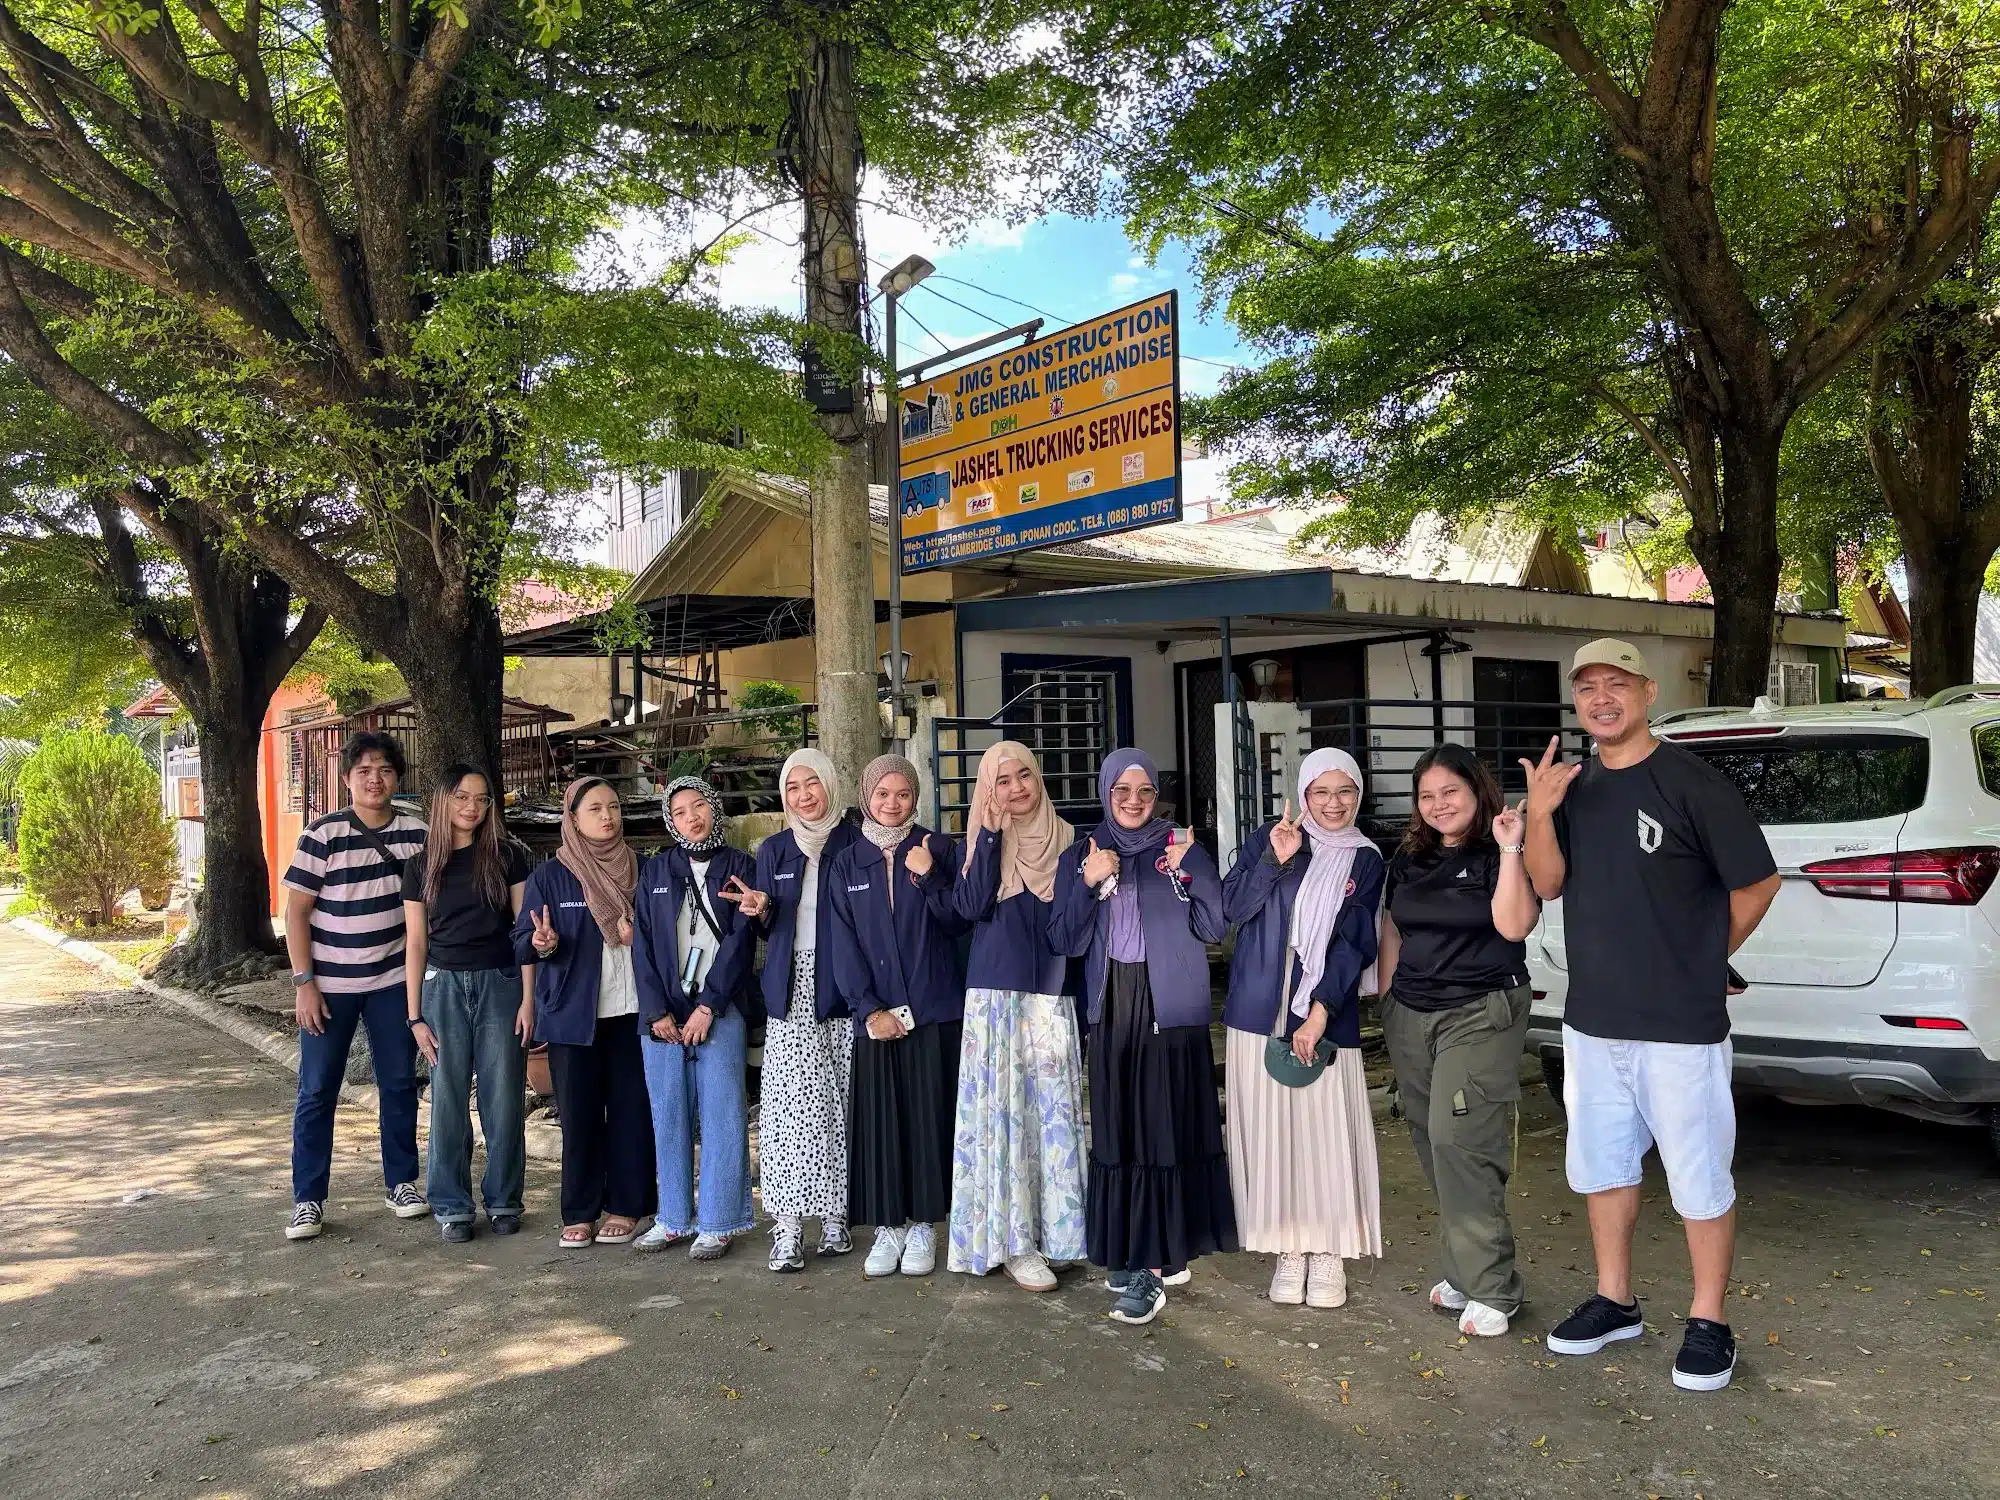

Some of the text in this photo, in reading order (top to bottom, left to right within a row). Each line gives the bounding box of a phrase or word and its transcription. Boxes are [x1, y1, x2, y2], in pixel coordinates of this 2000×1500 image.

[955, 302, 1171, 397] JMG CONSTRUCTION
[955, 333, 1172, 422] & GENERAL MERCHANDISE
[951, 399, 1173, 489] JASHEL TRUCKING SERVICES
[916, 477, 932, 495] JTS
[971, 496, 993, 510] FAST
[903, 552, 919, 567] BLK.
[919, 551, 925, 563] 7
[926, 550, 939, 563] LOT
[940, 547, 950, 560] 32
[950, 538, 994, 557] CAMBRIDGE
[994, 535, 1019, 549] SUBD.
[1020, 526, 1051, 543] IPONAN
[1053, 520, 1080, 535] CDOC.
[1107, 506, 1130, 529] (088)
[1131, 505, 1149, 520] 880
[1150, 497, 1175, 517] 9757
[904, 540, 924, 552] Web:
